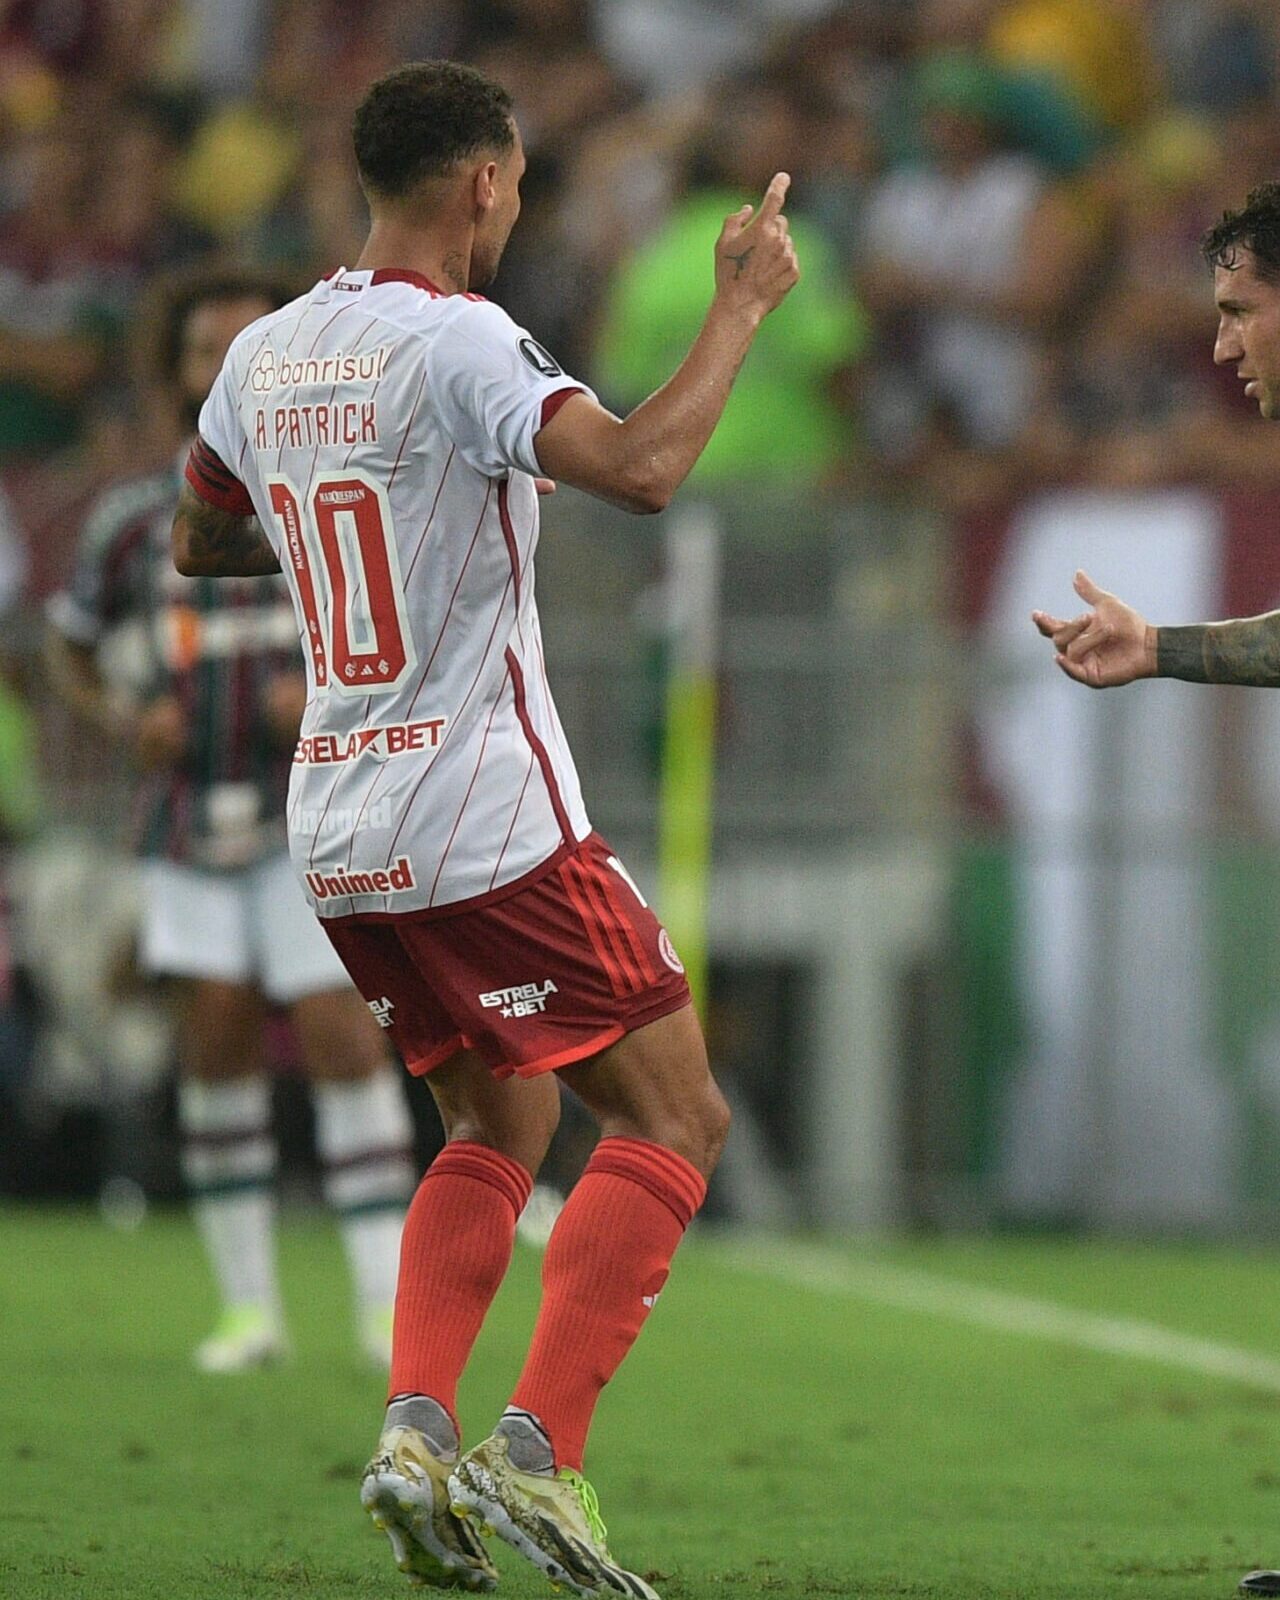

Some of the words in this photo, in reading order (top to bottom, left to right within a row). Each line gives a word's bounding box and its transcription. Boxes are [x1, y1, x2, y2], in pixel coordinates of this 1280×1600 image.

[280, 348, 384, 385] banrisul
[267, 478, 407, 687] 10
[386, 719, 445, 755] BET
[306, 858, 414, 899] Unimed
[478, 979, 559, 1008] ESTRELA
[512, 996, 547, 1018] BET
